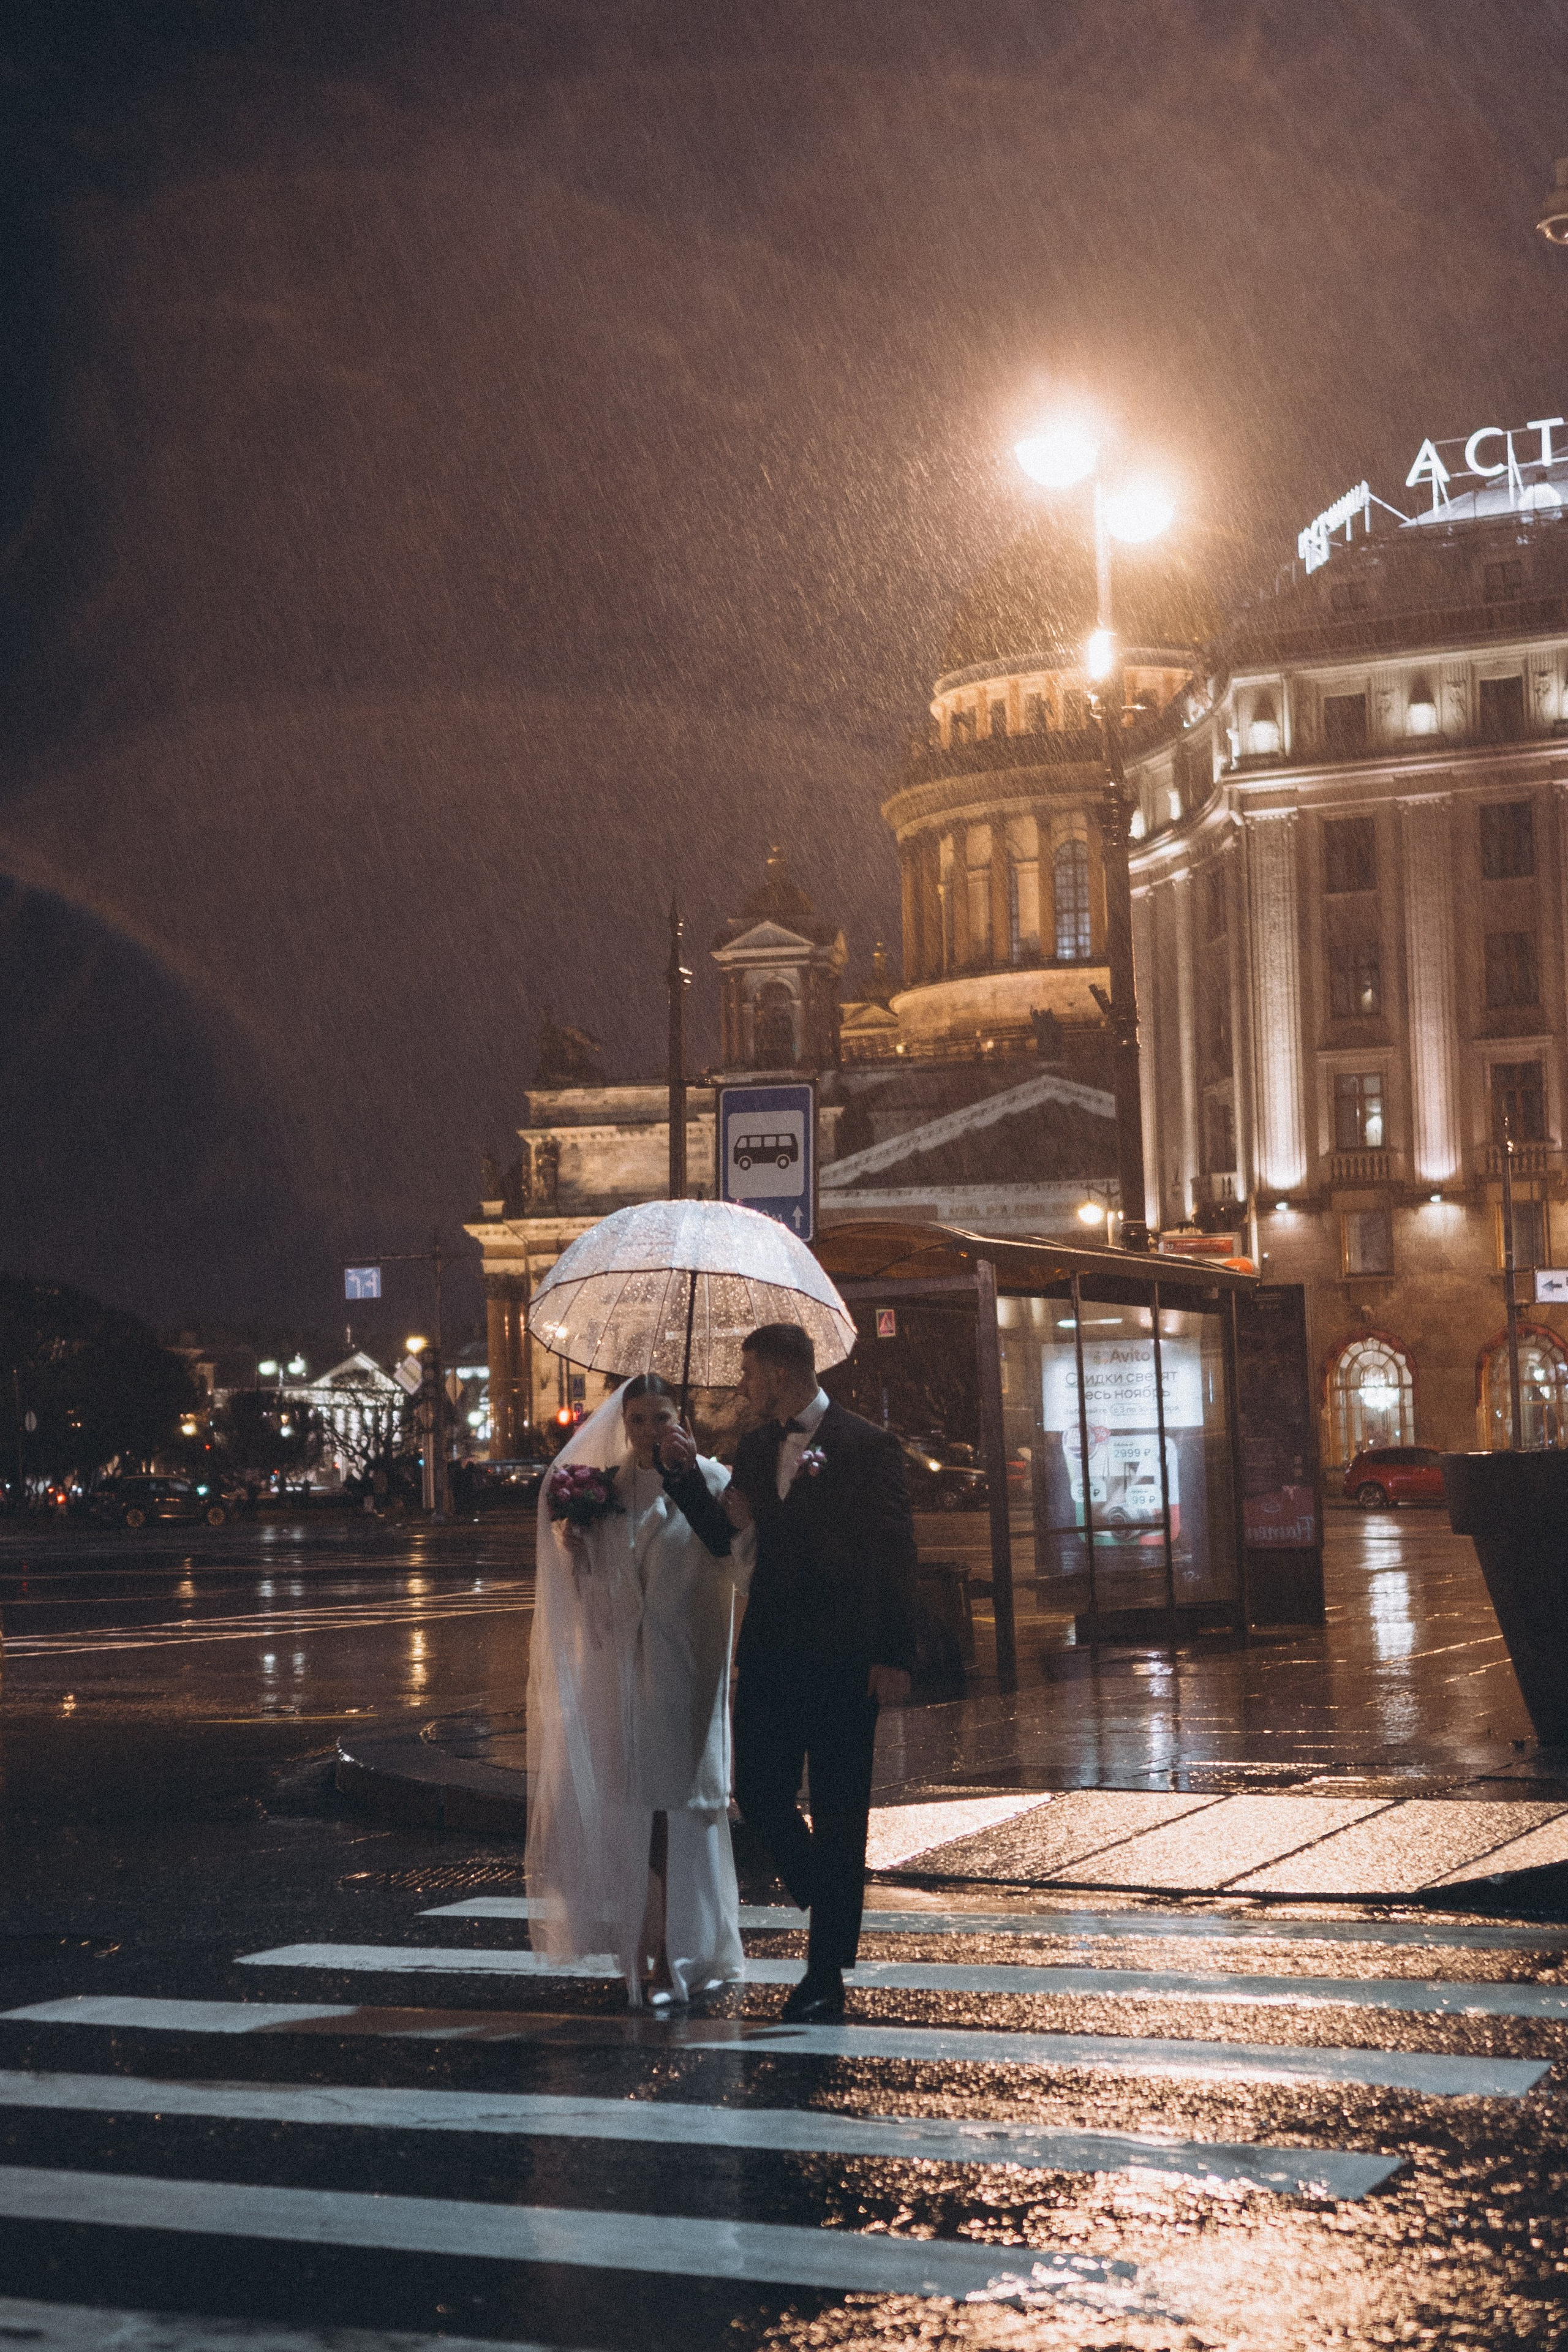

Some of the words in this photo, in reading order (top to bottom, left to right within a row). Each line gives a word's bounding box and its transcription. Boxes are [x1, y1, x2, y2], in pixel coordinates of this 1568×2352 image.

[1110, 1348, 1151, 1363] Avito
[1065, 1372, 1123, 1385] Сидки
[1126, 1371, 1177, 1382] свеят
[1084, 1390, 1111, 1400] есь
[1114, 1448, 1140, 1458] 2999
[1132, 1496, 1145, 1504] 99
[1183, 1570, 1200, 1582] 12+
